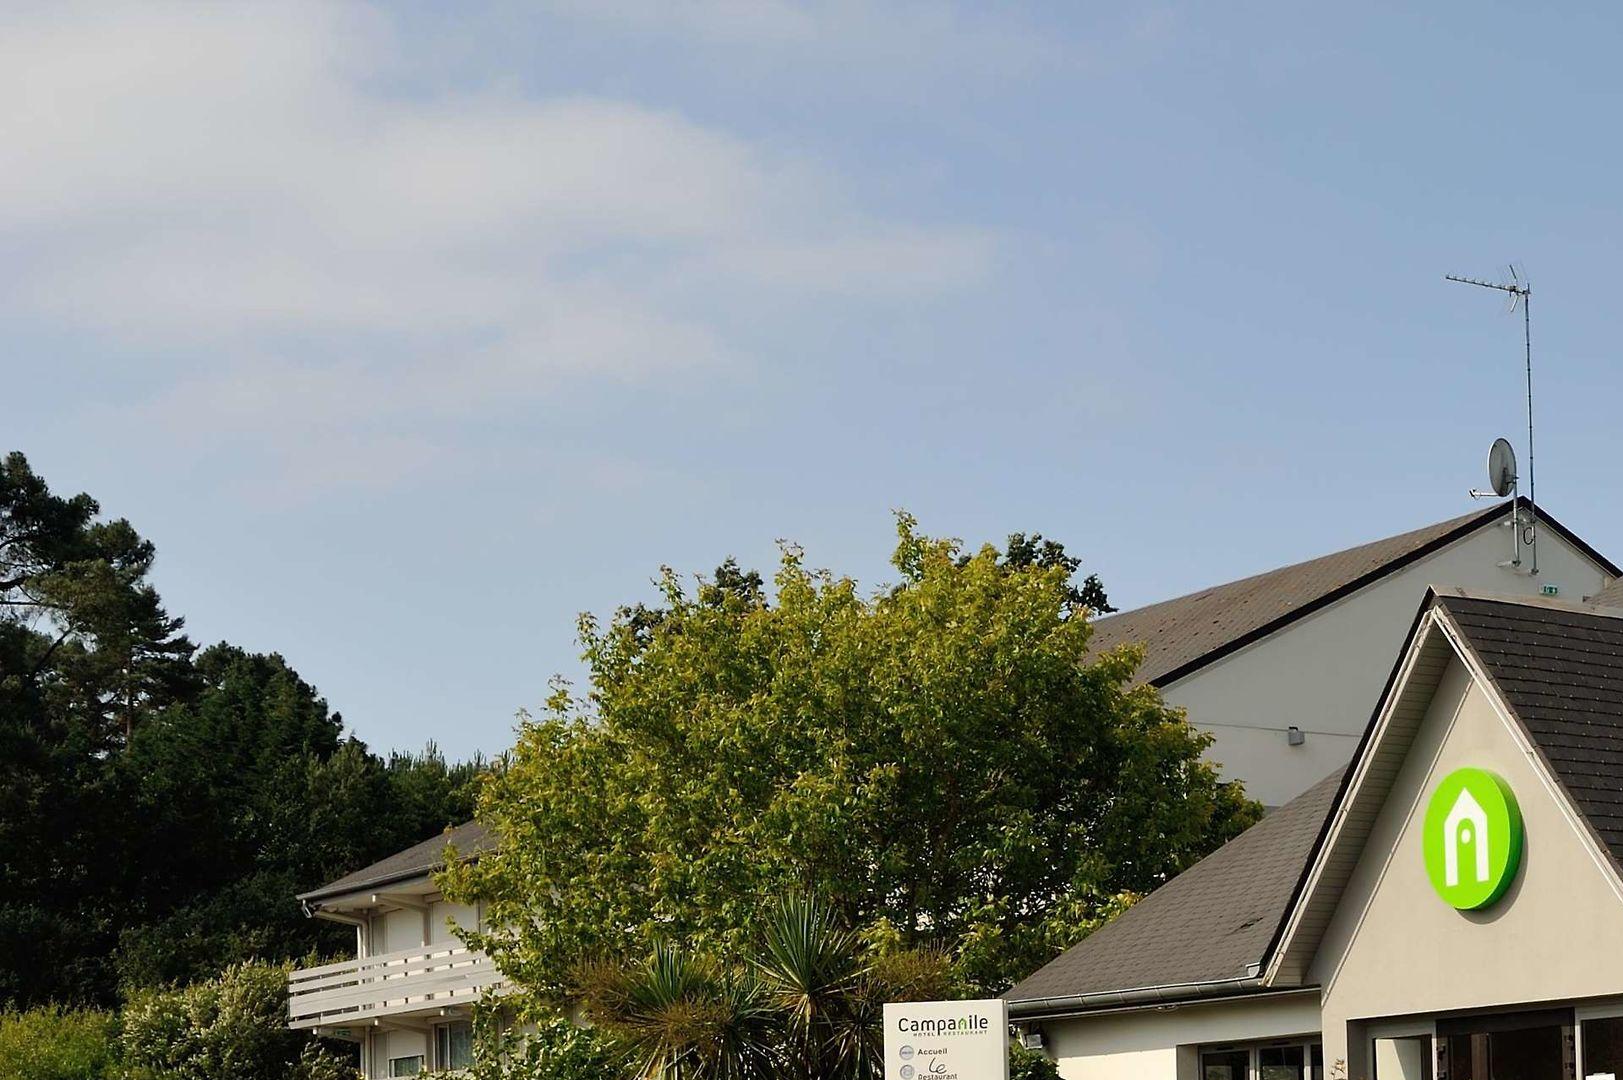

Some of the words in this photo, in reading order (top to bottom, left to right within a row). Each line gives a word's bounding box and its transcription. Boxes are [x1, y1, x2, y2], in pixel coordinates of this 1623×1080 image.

[898, 1015, 989, 1035] Campanile
[917, 1048, 948, 1056] Accueil
[917, 1073, 958, 1080] Restaurant
